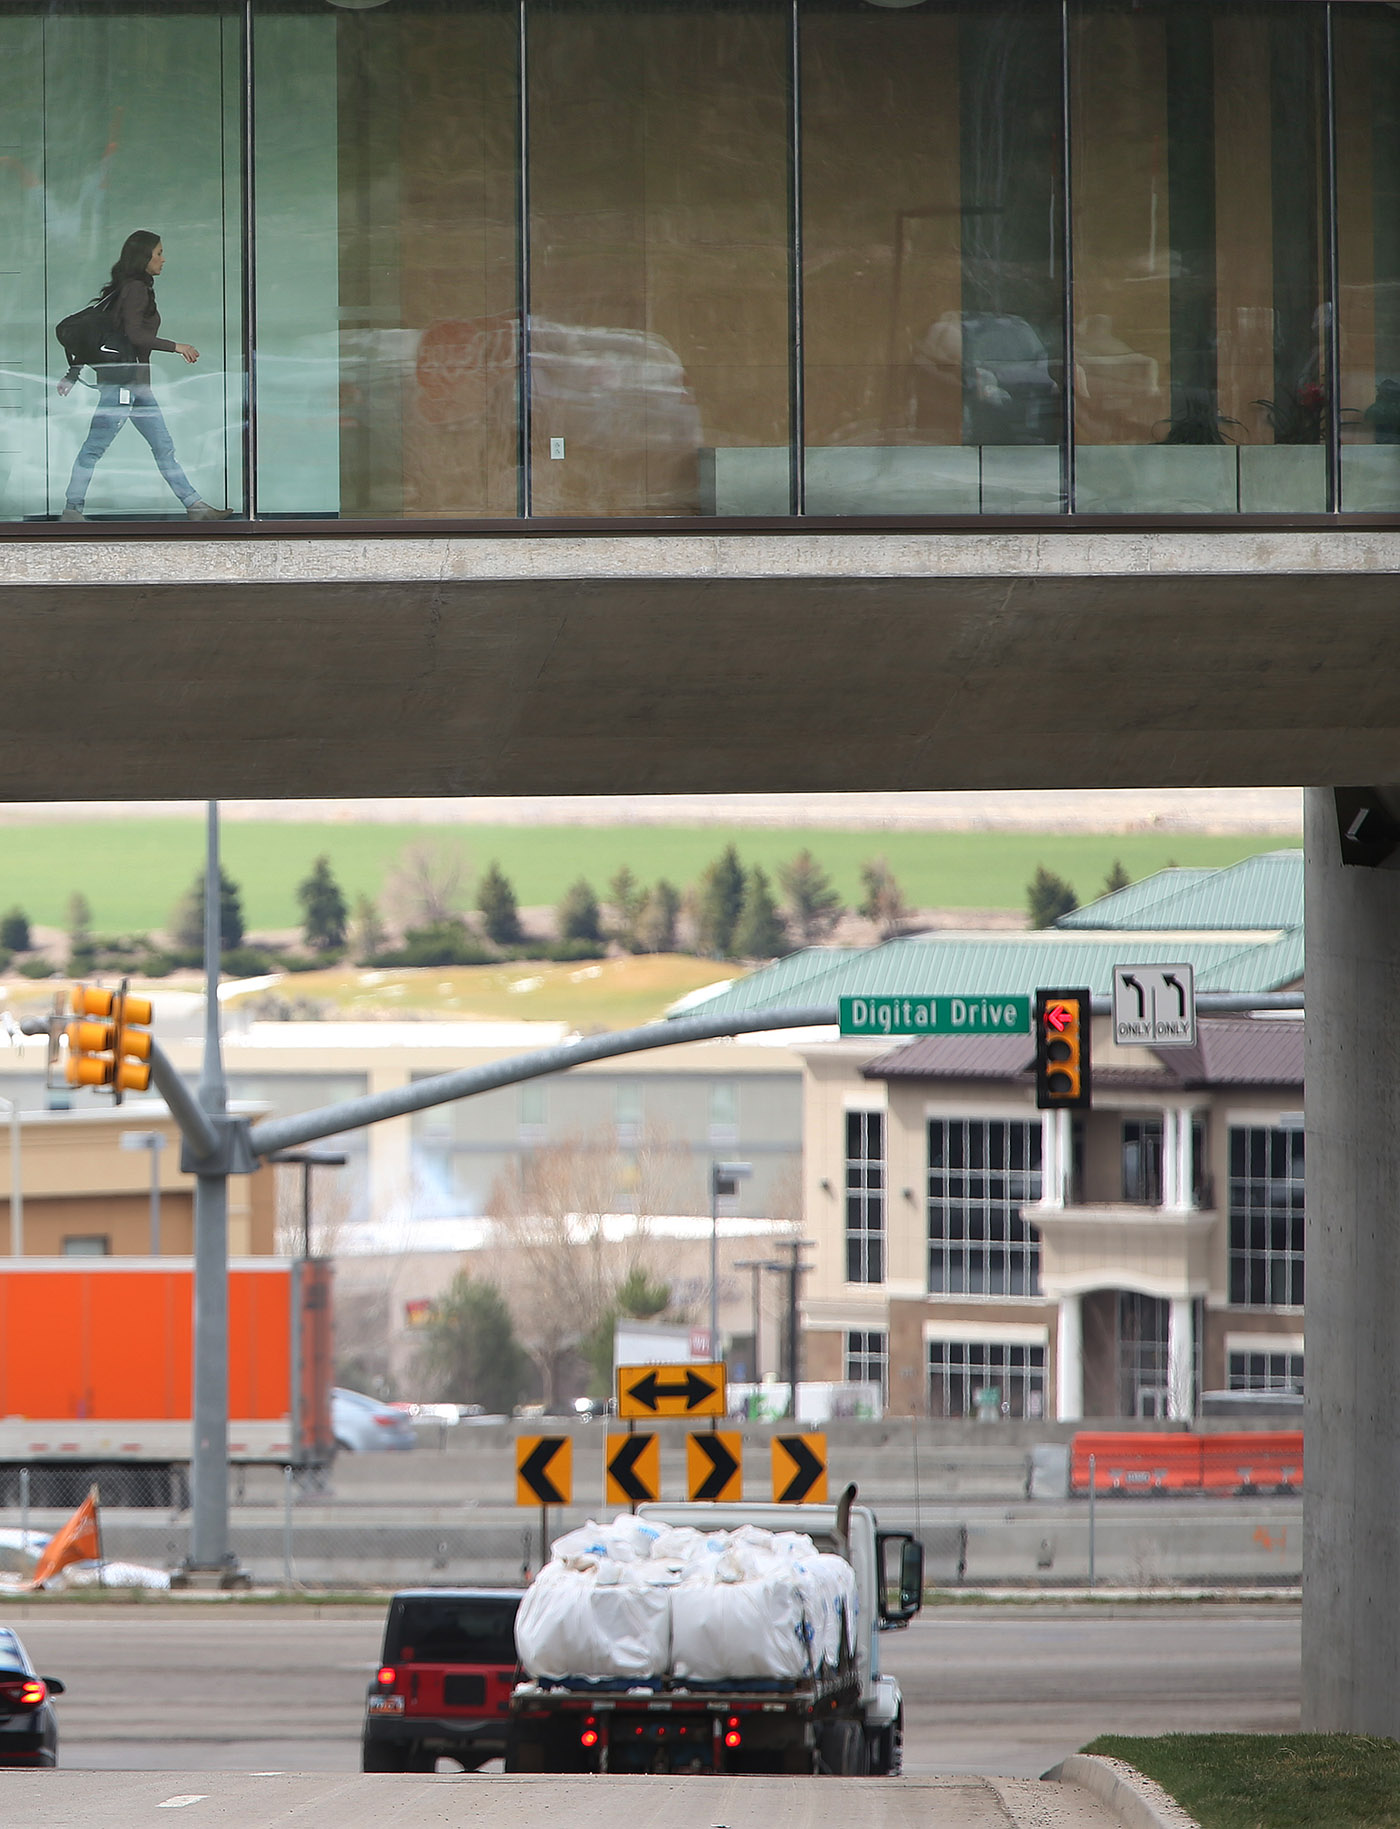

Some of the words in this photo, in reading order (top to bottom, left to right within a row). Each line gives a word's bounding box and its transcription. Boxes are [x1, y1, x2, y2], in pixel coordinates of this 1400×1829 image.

[852, 999, 936, 1033] Digital
[951, 999, 1017, 1027] Drive
[1118, 1022, 1151, 1036] ONLY
[1157, 1021, 1189, 1035] ONLY
